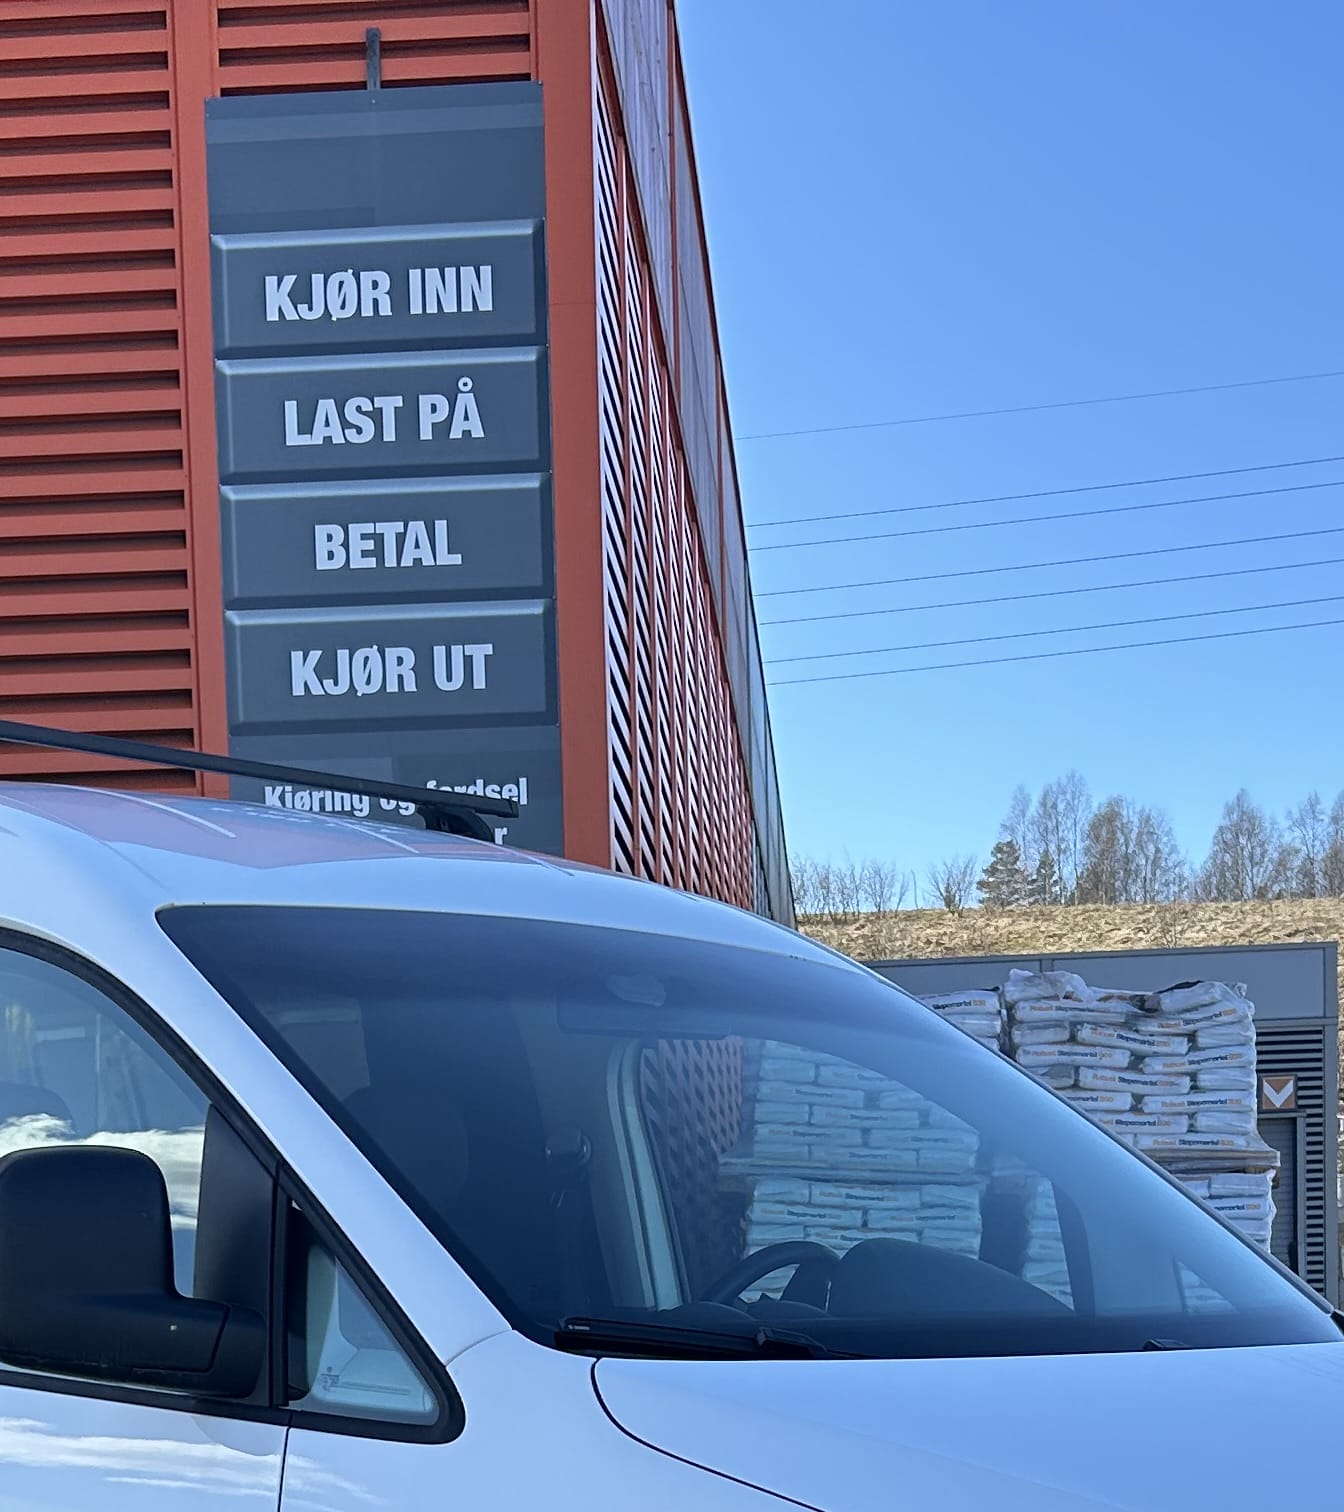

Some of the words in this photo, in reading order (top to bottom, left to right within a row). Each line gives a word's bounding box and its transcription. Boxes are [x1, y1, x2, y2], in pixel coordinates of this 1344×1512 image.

[264, 270, 392, 323] KJØR
[409, 264, 494, 315] INN
[283, 394, 403, 447] LAST
[419, 376, 486, 441] PÅ
[314, 518, 462, 571] BETAL
[290, 643, 416, 698] KJØR
[432, 642, 494, 692] UT
